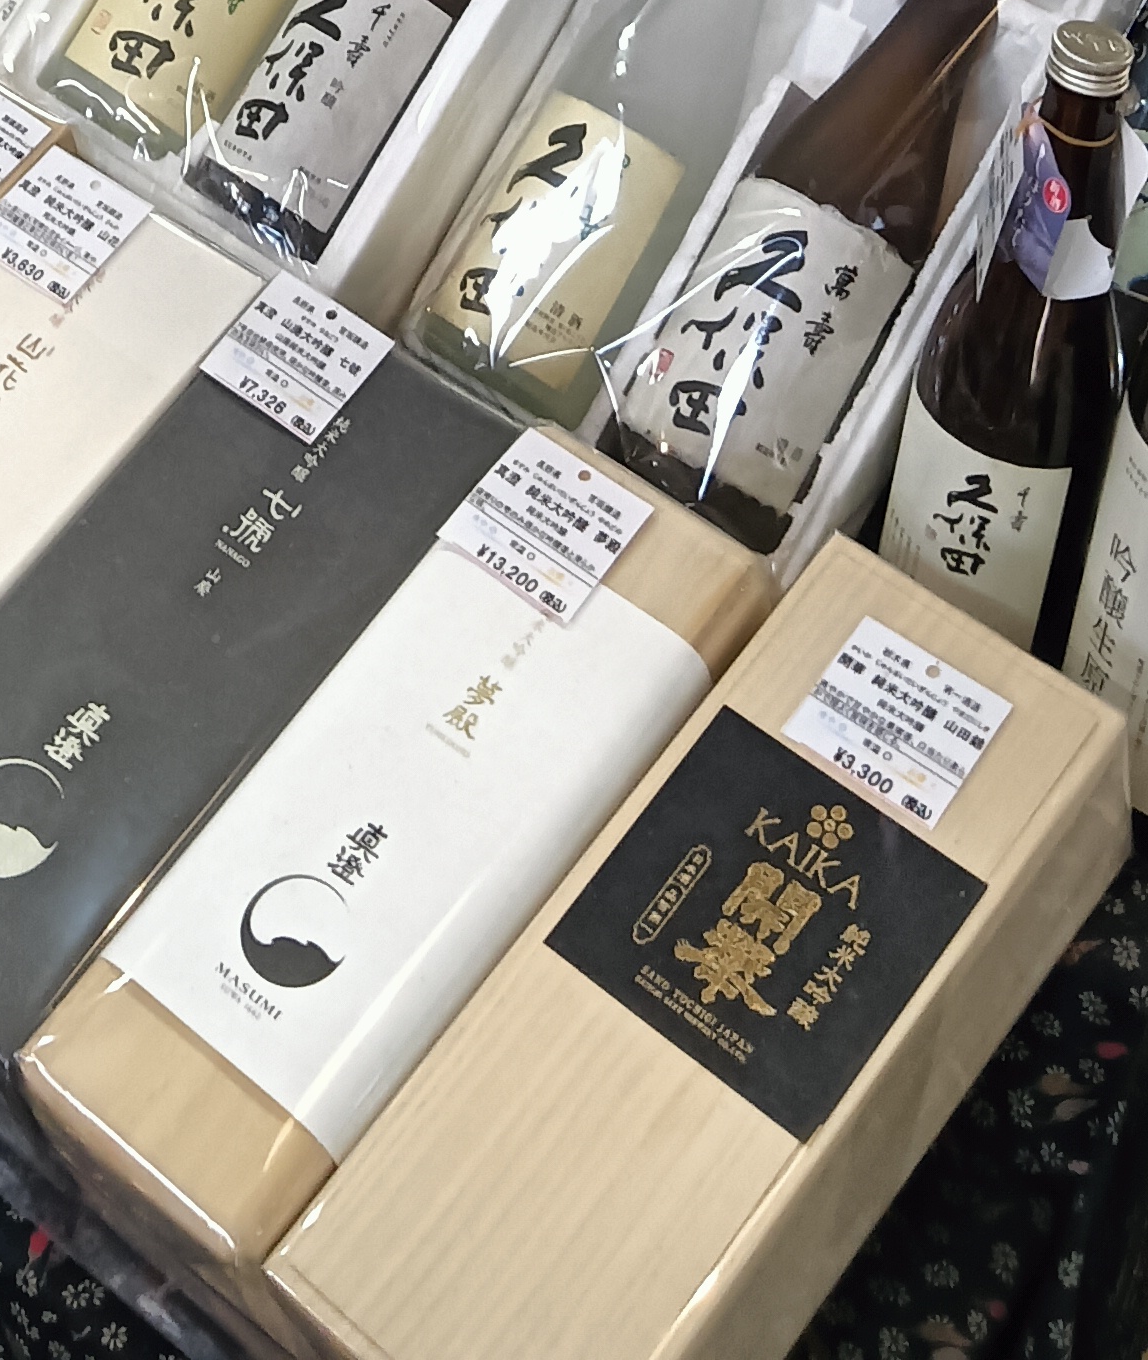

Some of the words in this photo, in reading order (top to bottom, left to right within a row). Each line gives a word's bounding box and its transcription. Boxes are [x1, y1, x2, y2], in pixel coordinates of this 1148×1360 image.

[320, 75, 346, 110] 吟醸
[43, 194, 95, 232] 純米大吟醸
[97, 228, 120, 248] 山花
[0, 247, 45, 283] ¥3,630
[669, 229, 809, 437] 久保田
[239, 375, 288, 415] ¥7,326
[493, 462, 521, 487] 真澄
[524, 483, 590, 533] 純米大吟醸
[593, 529, 622, 554] 夢殿
[931, 473, 1000, 576] 久保田
[213, 537, 251, 569] NANAGO
[475, 543, 540, 595] ¥13,200
[43, 701, 111, 771] 真澄
[441, 674, 504, 742] 夢殿
[871, 673, 939, 722] 純米大吟醸
[942, 718, 986, 751] 山田錦
[832, 746, 896, 795] ¥3,300
[326, 821, 390, 887] 真澄
[743, 805, 865, 912] KAIKA
[672, 858, 824, 1019] 開華
[214, 961, 284, 1022] MASUMI
[801, 921, 873, 1032] 純米大吟醸
[715, 1022, 755, 1057] JAPAN
